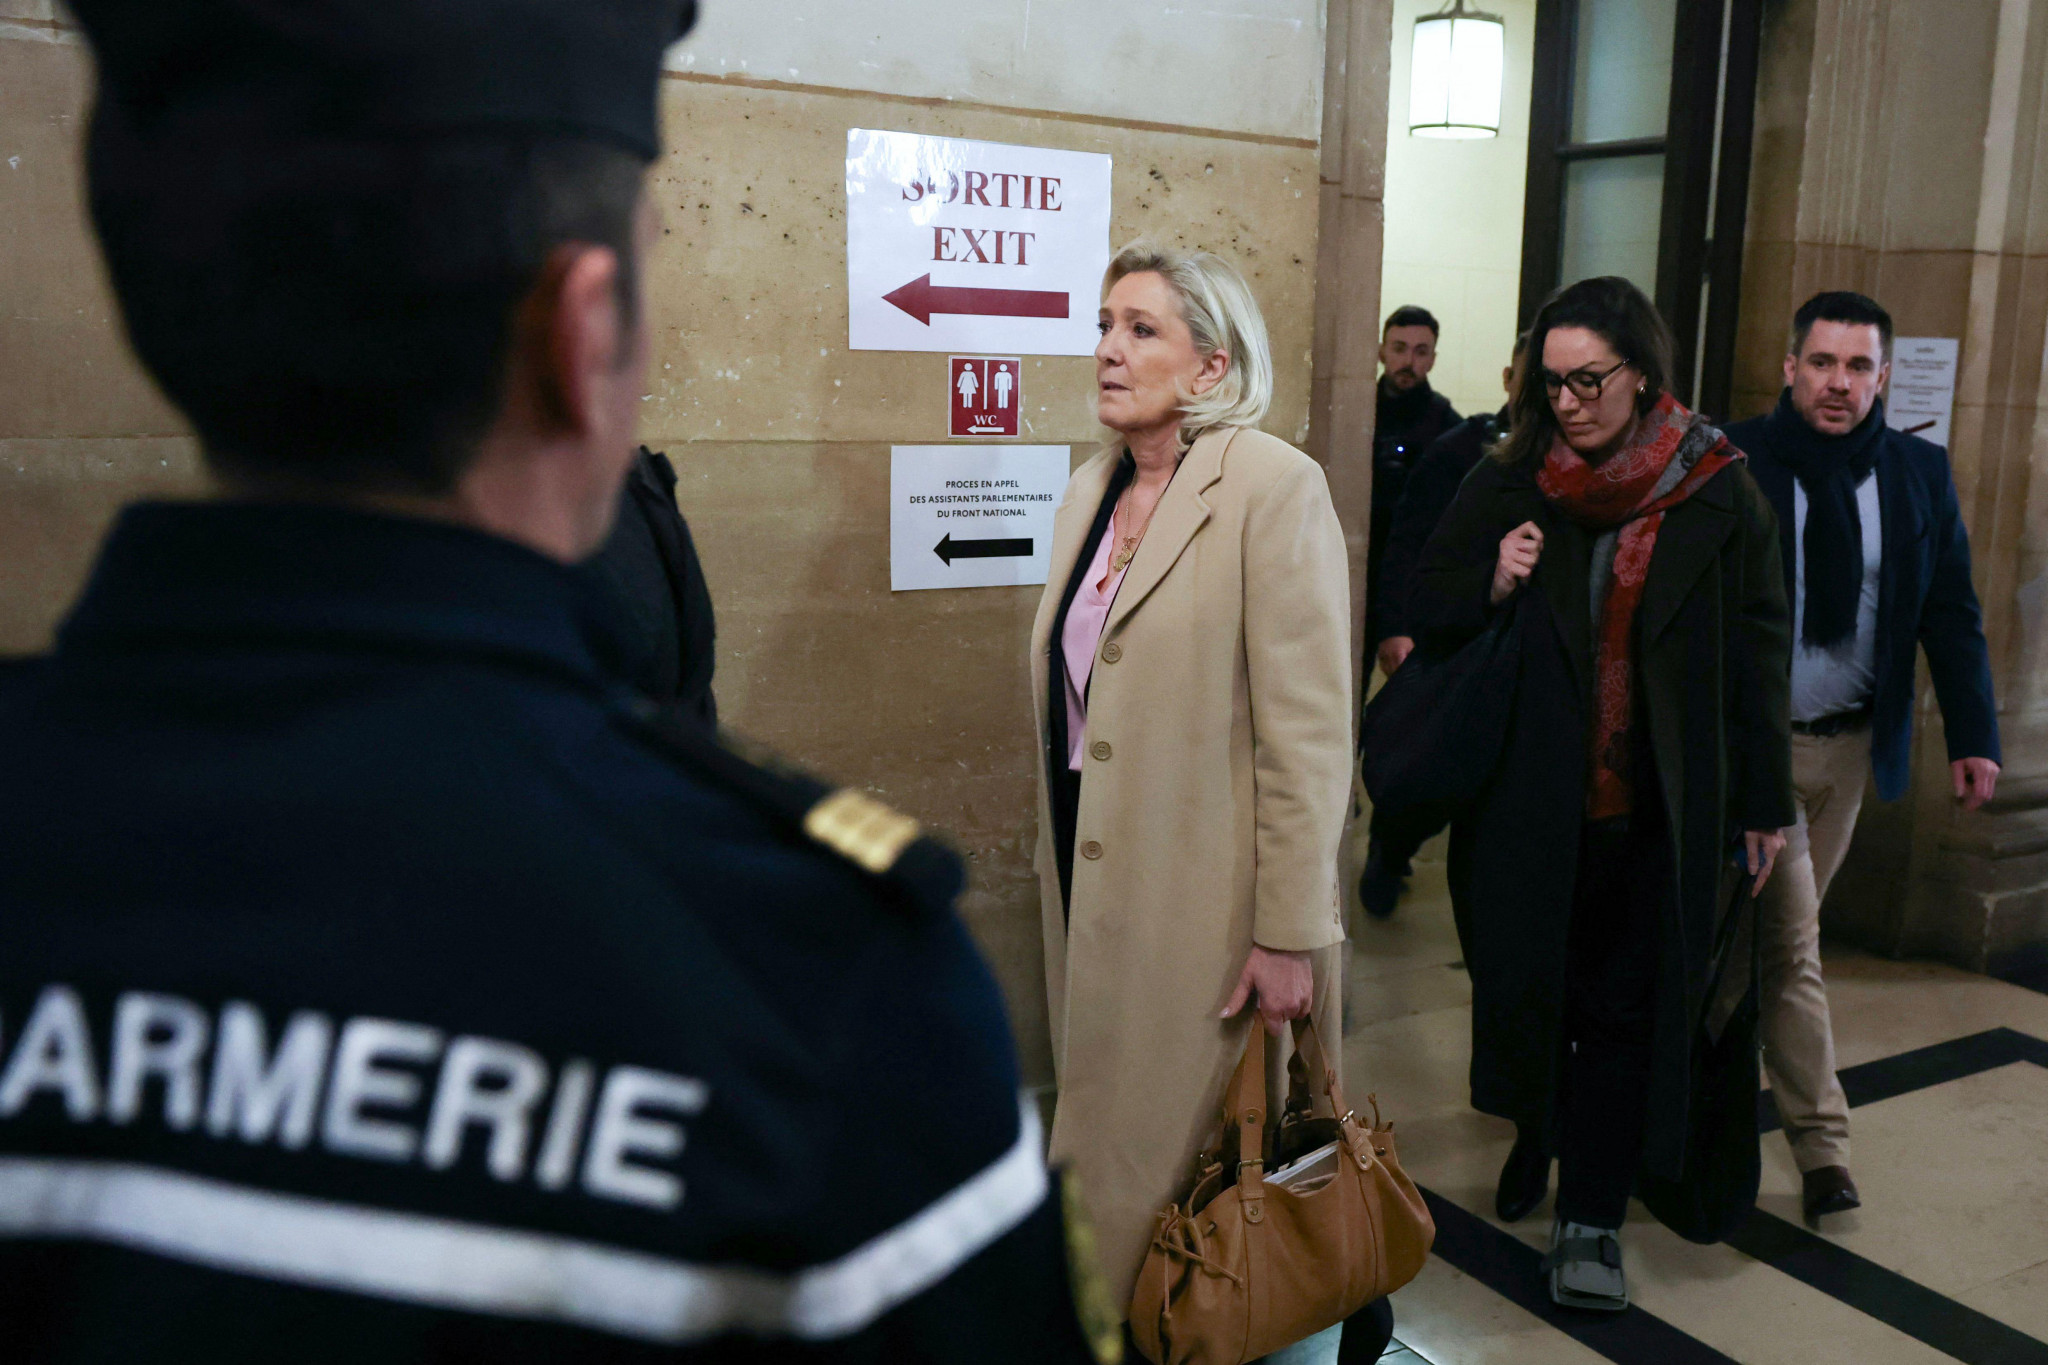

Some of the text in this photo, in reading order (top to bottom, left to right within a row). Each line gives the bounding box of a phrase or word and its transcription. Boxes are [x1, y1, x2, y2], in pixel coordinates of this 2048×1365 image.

[930, 226, 1036, 266] EXIT
[974, 414, 997, 426] WC
[945, 480, 1019, 489] PROCES EN APPEL
[909, 493, 1053, 504] DES ASSISTANTS PARLEMENTAIRES
[937, 508, 1026, 518] DU FRONT NATIONAL
